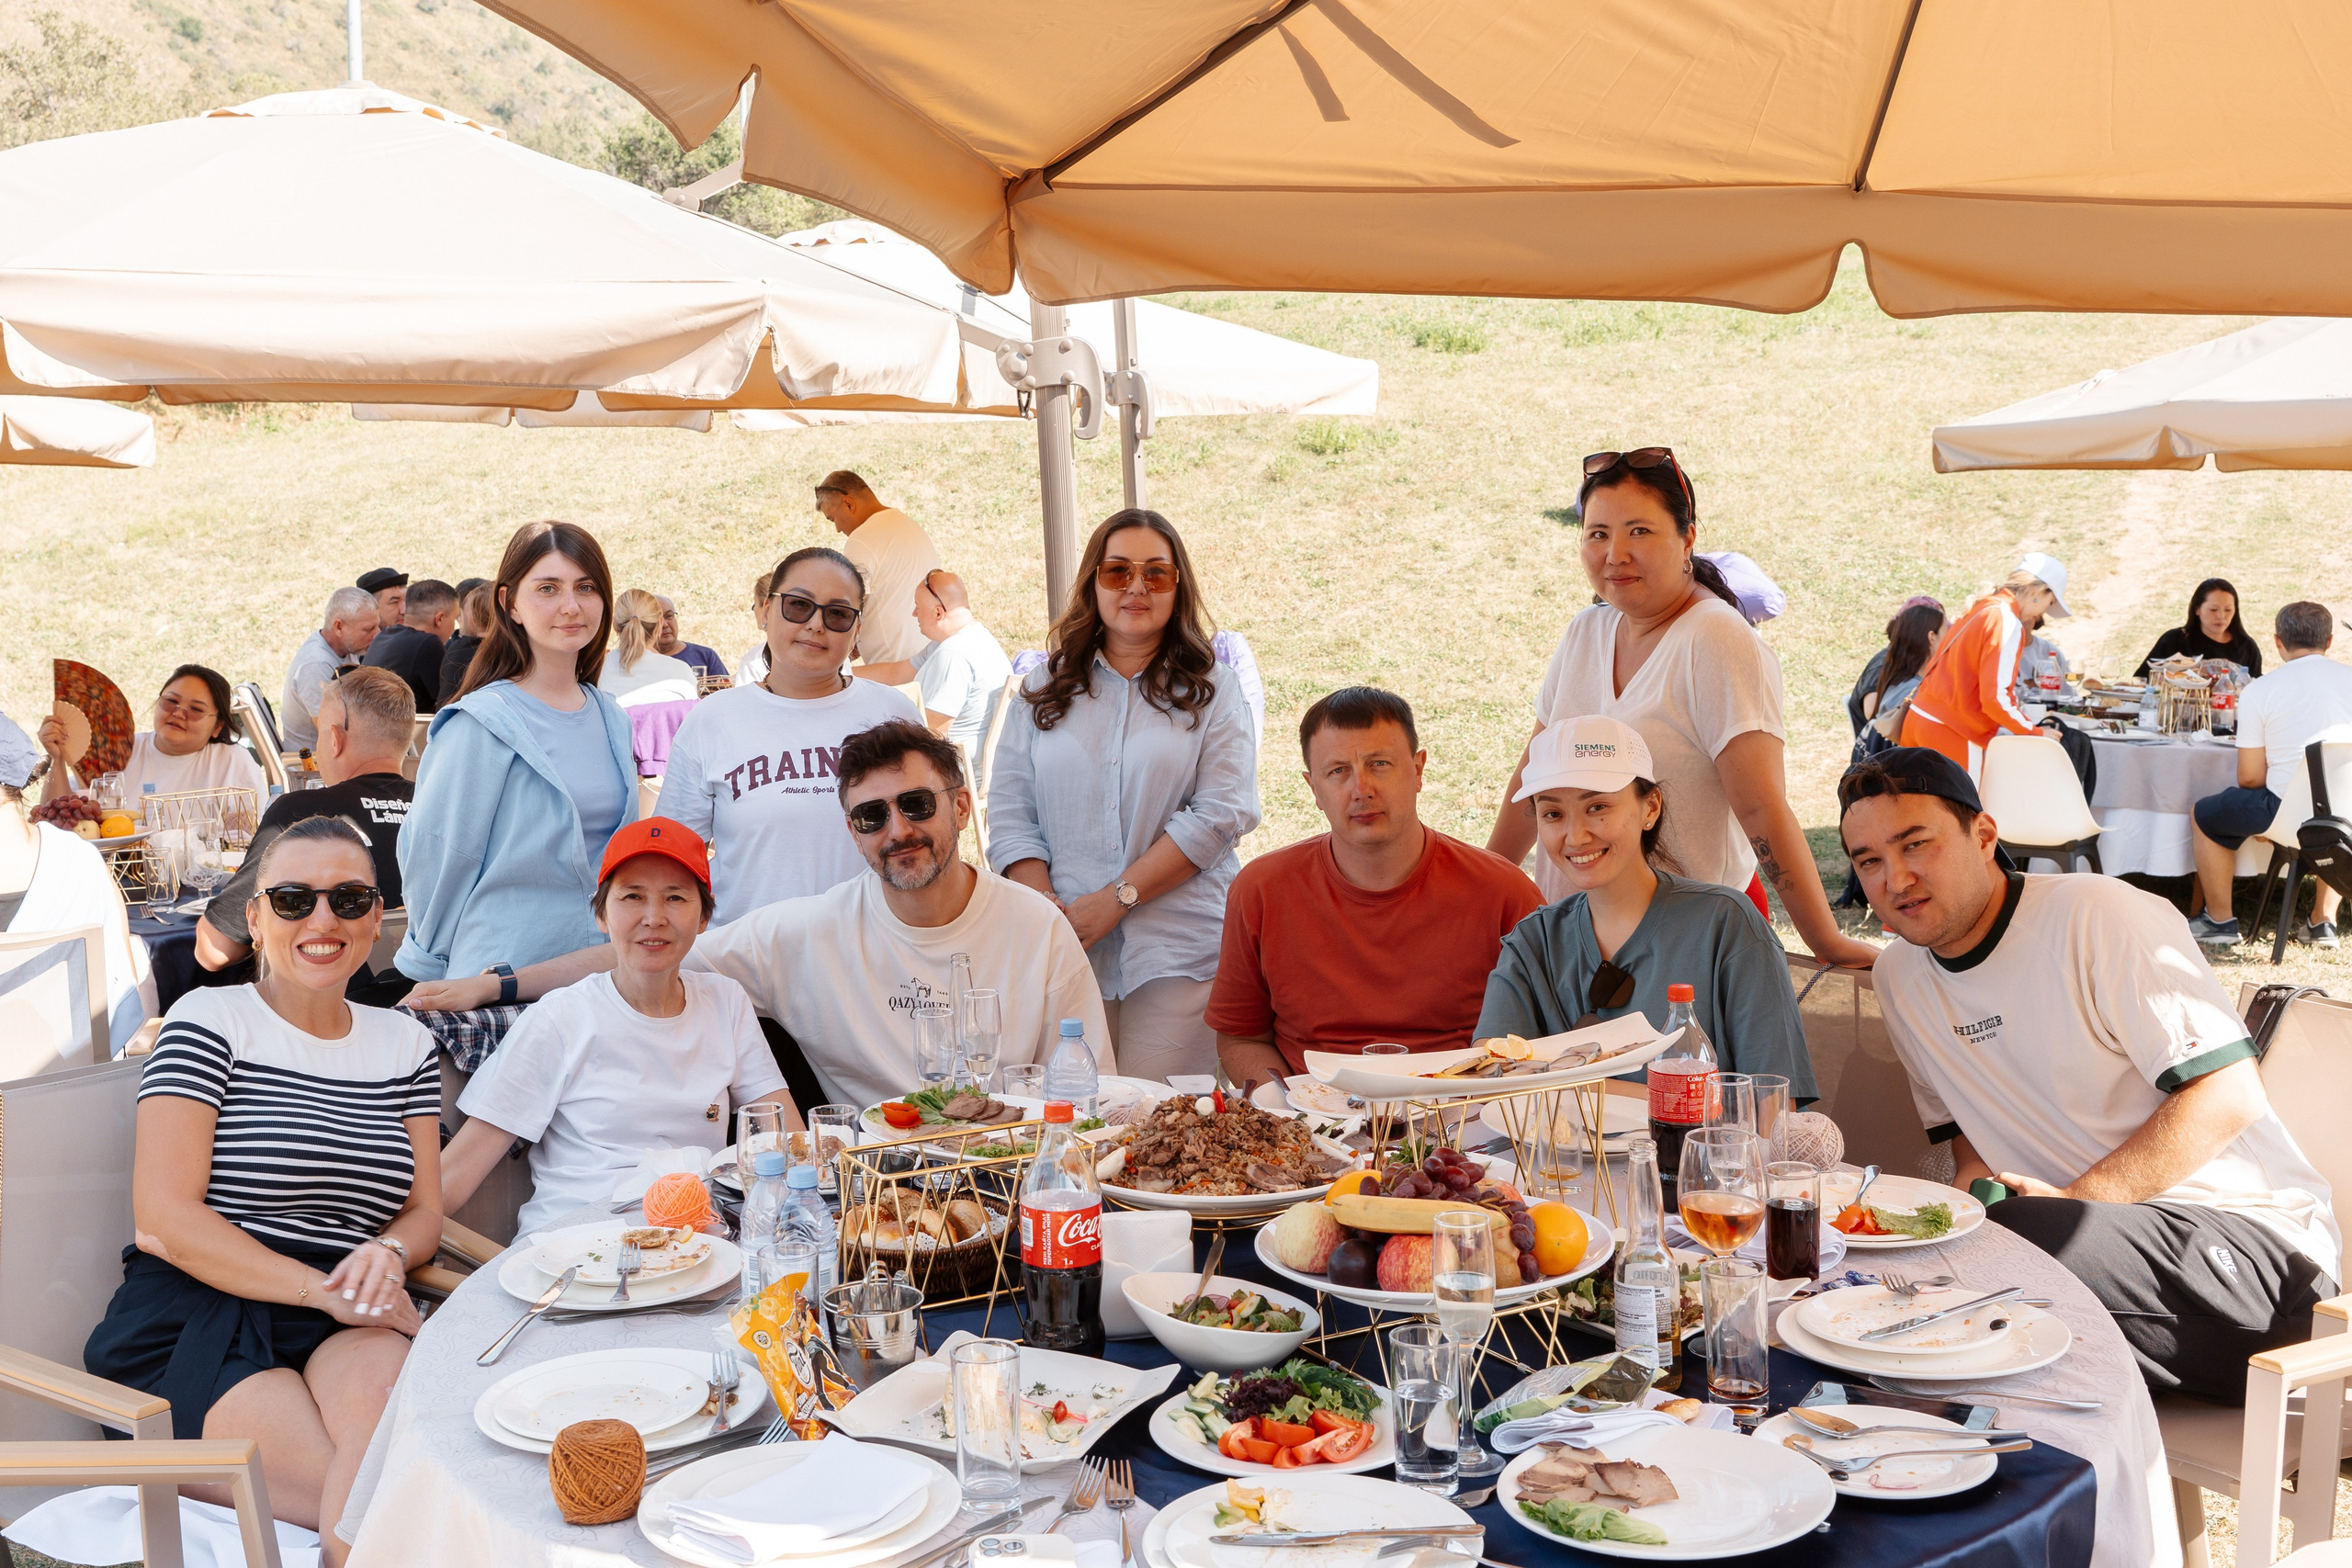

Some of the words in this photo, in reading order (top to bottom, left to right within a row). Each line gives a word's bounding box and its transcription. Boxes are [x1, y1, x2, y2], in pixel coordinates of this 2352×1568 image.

[1574, 743, 1616, 751] SIEMENS
[781, 786, 810, 795] Athletic
[812, 785, 835, 795] Sports
[650, 828, 662, 838] D
[888, 996, 917, 1011] QAZY
[1970, 1034, 1986, 1043] NEW
[2217, 1248, 2238, 1274] NIKE
